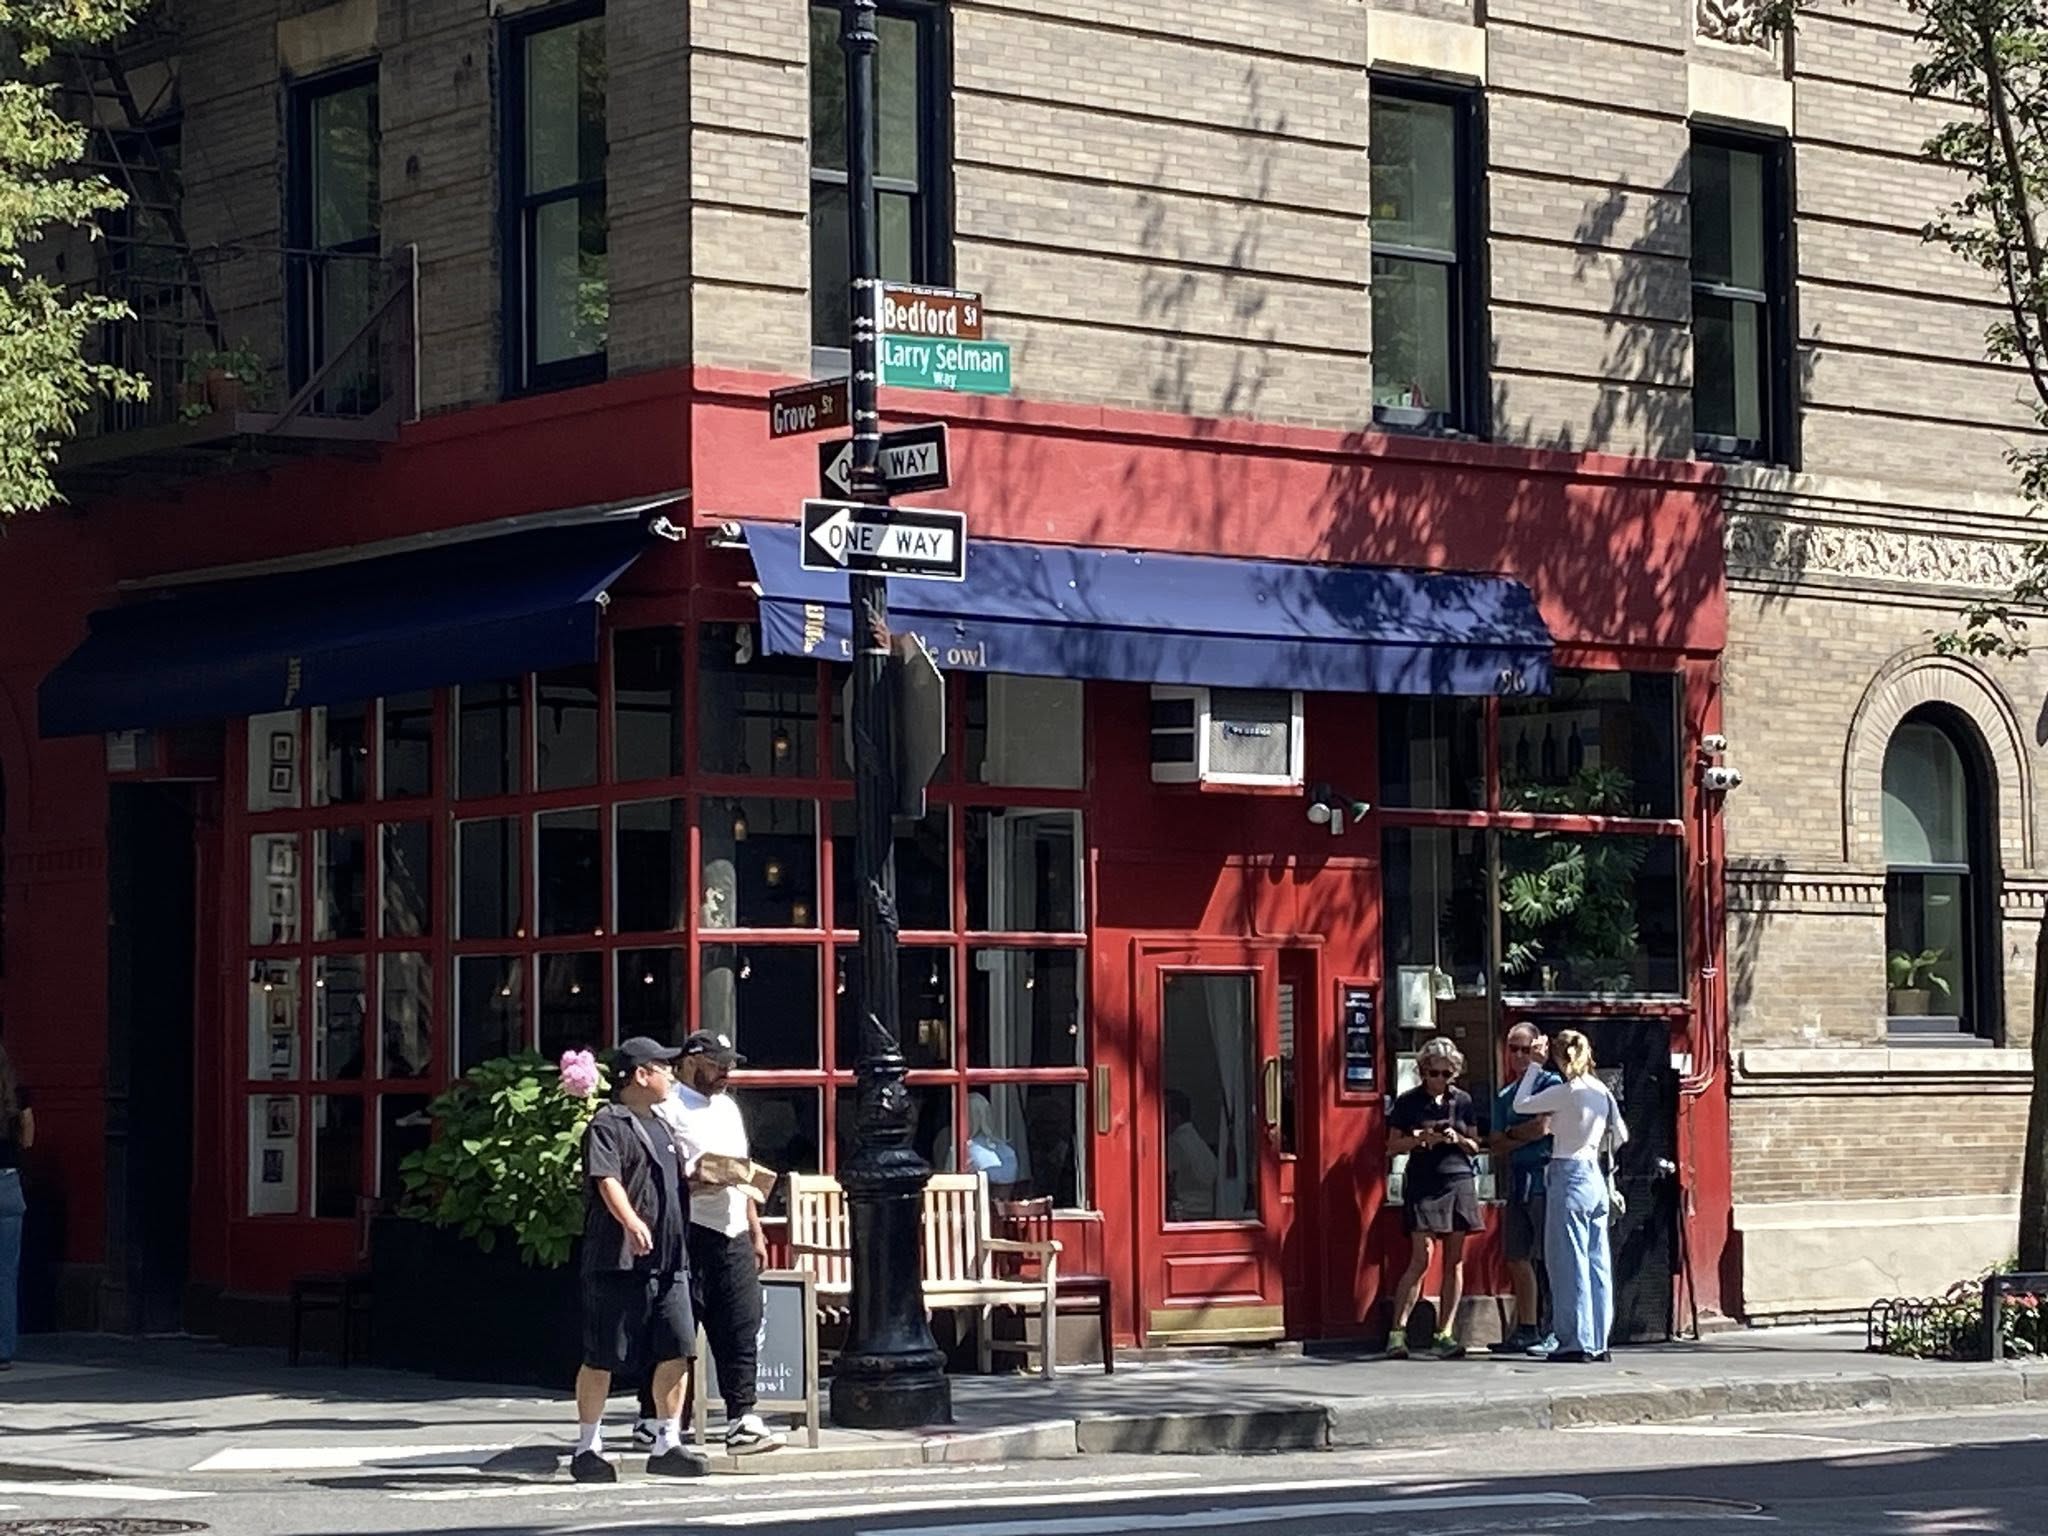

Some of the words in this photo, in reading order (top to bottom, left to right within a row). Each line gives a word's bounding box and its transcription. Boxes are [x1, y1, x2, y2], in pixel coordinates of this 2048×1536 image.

[884, 297, 957, 335] Bedford
[963, 305, 977, 327] St
[885, 340, 930, 375] Larry
[936, 343, 1004, 373] Selman
[774, 402, 816, 434] Grove
[821, 394, 833, 414] St
[890, 446, 930, 475] WAY
[828, 524, 873, 553] ONE
[896, 529, 942, 558] WAY
[947, 641, 987, 667] owl
[756, 1378, 785, 1392] owl
